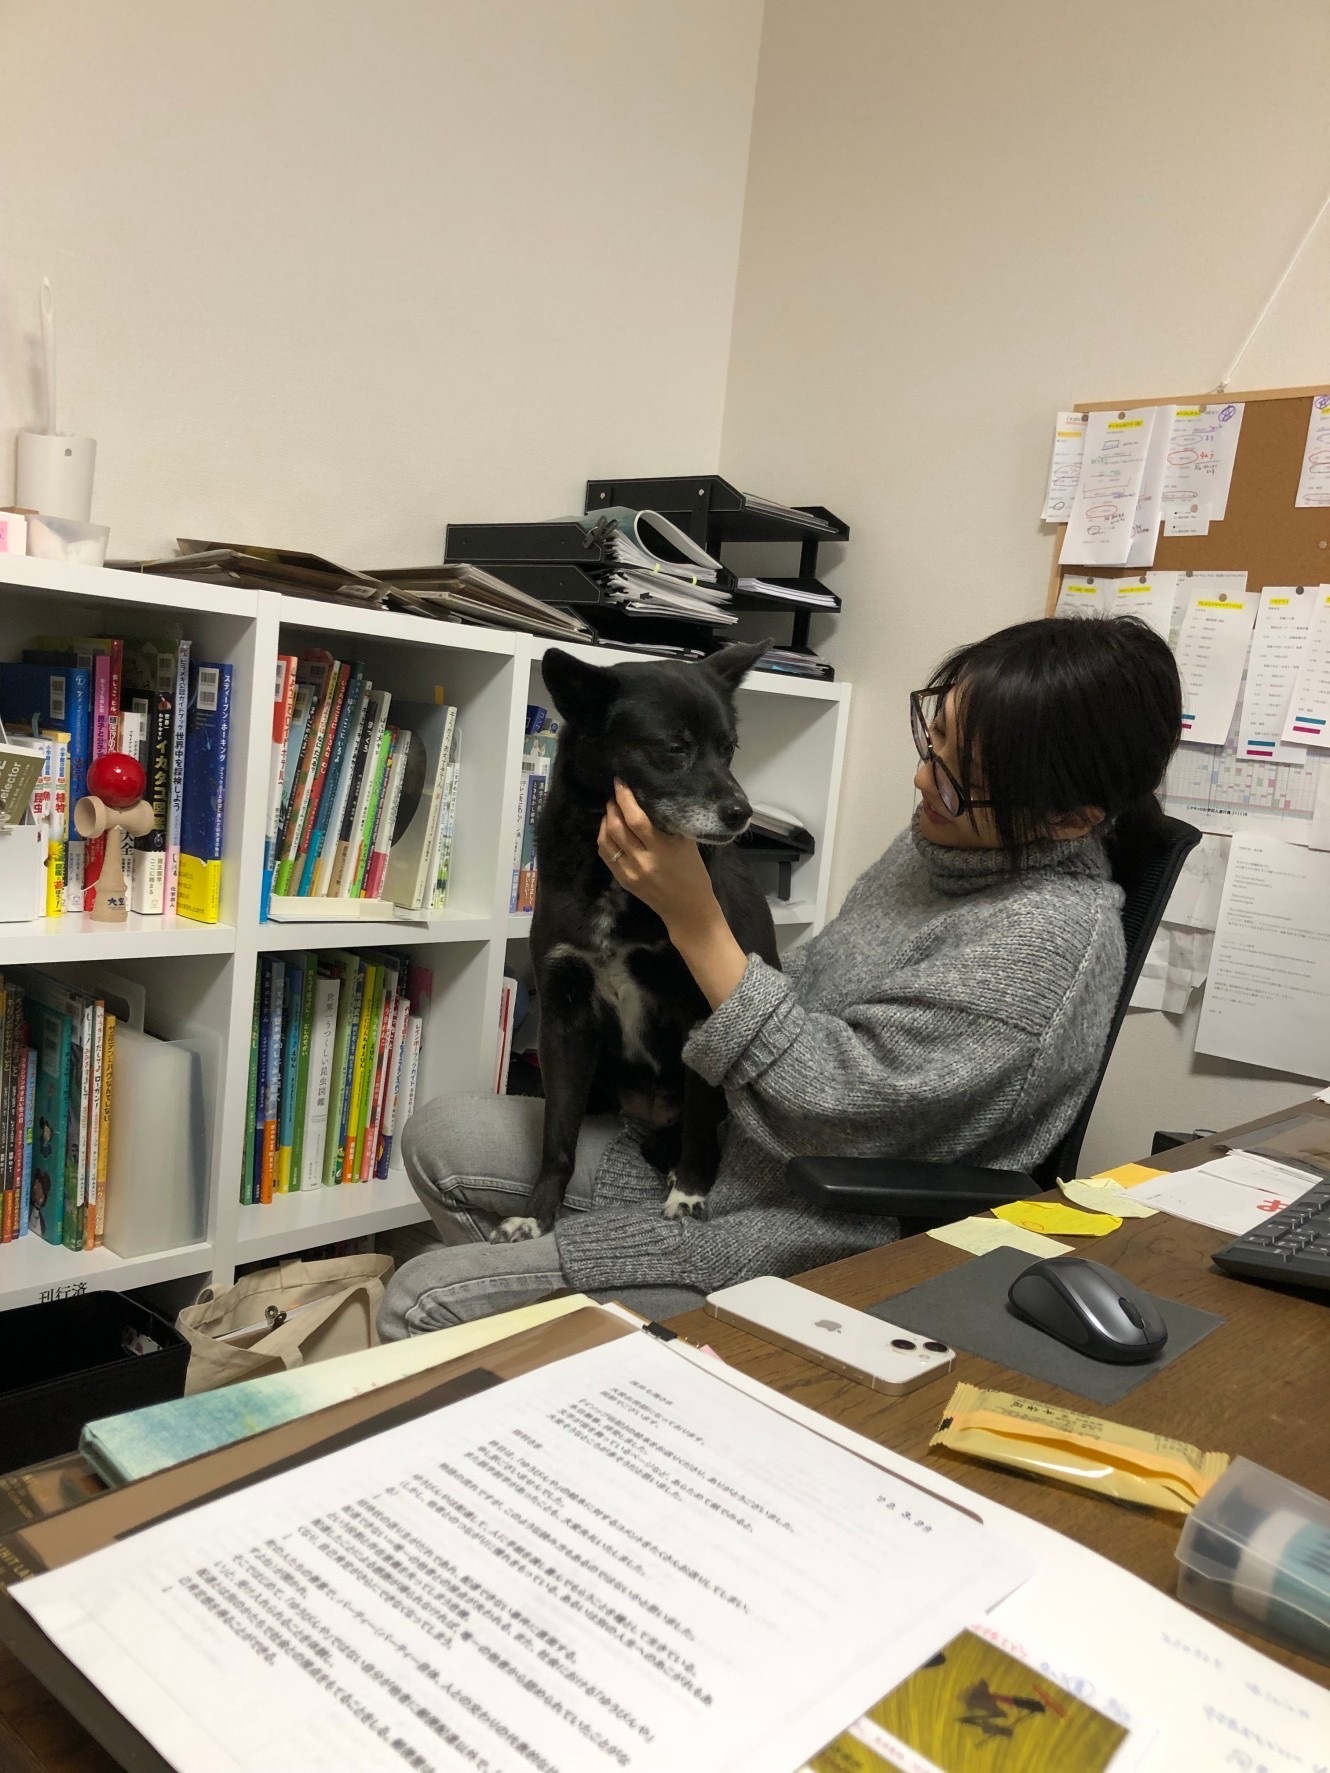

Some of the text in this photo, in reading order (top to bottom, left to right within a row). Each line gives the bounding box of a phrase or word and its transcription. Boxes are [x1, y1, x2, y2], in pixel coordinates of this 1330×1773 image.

[54, 791, 66, 813] 植物
[316, 991, 336, 1108] 世界一うつくしい昆虫図鑑
[39, 1282, 88, 1303] 刊行済
